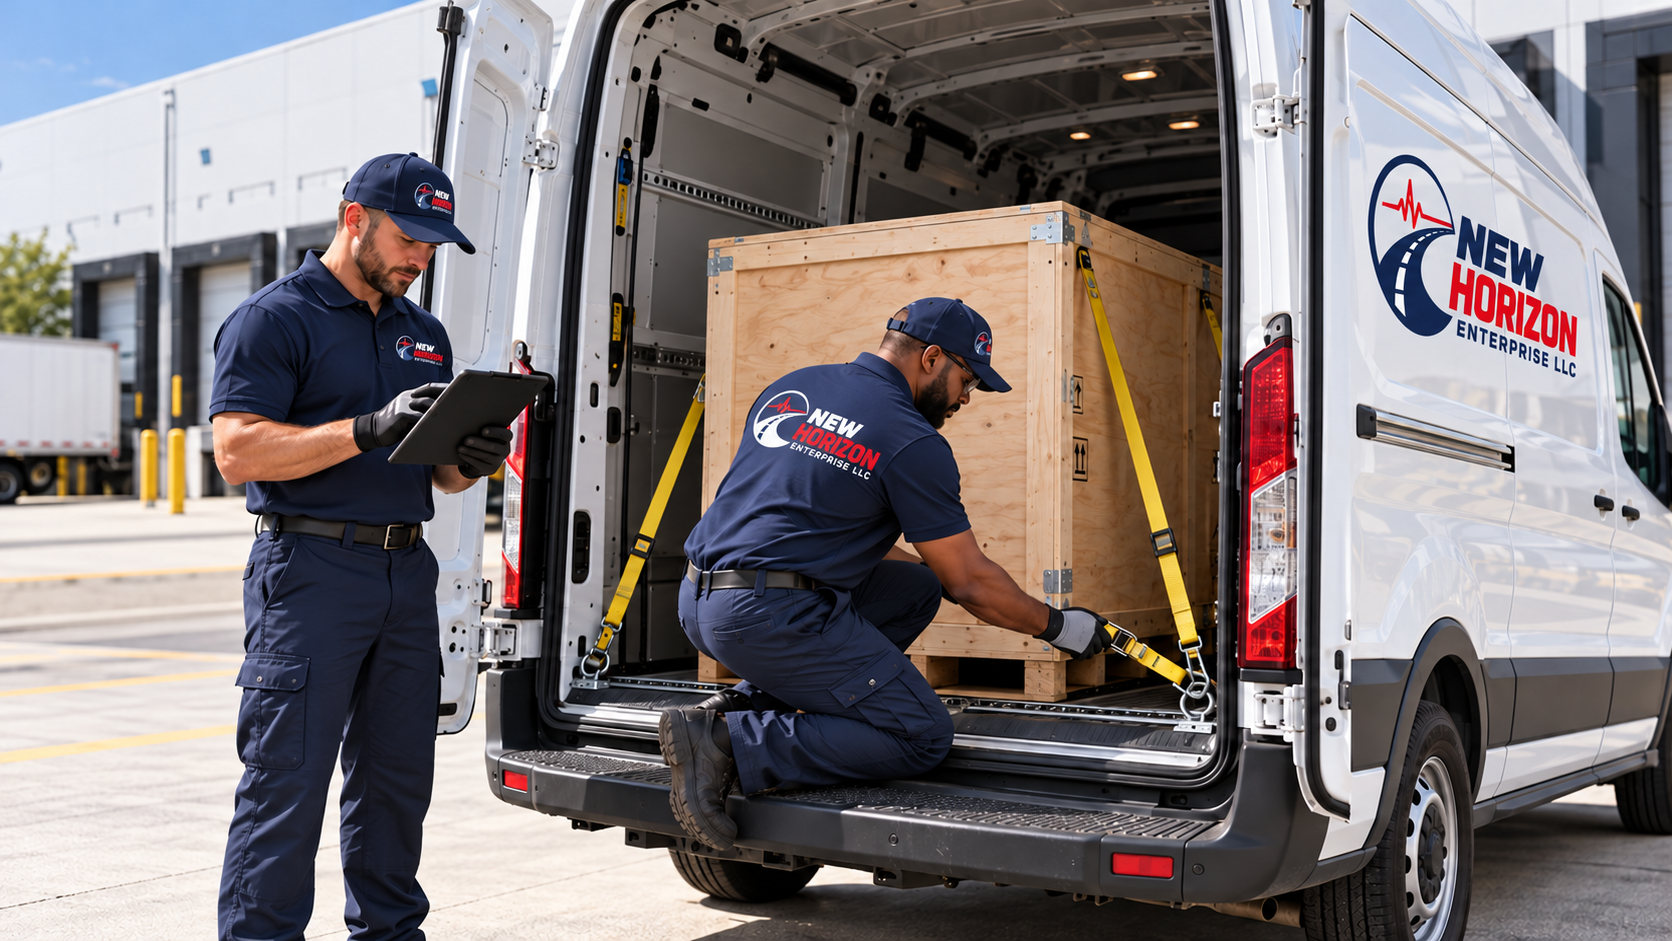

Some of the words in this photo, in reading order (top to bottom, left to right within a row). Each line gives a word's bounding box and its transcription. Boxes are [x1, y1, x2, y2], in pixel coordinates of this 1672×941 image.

[434, 189, 450, 200] NEW
[1456, 215, 1544, 293] NEW
[1449, 261, 1578, 357] HORIZON
[415, 341, 435, 353] NEW
[1456, 319, 1549, 368] ENTERPRISE
[1554, 356, 1577, 378] LLC
[806, 408, 864, 439] NEW
[790, 442, 850, 471] ENTERPRISE
[852, 466, 871, 480] LLC
[791, 422, 881, 471] HORIZON
